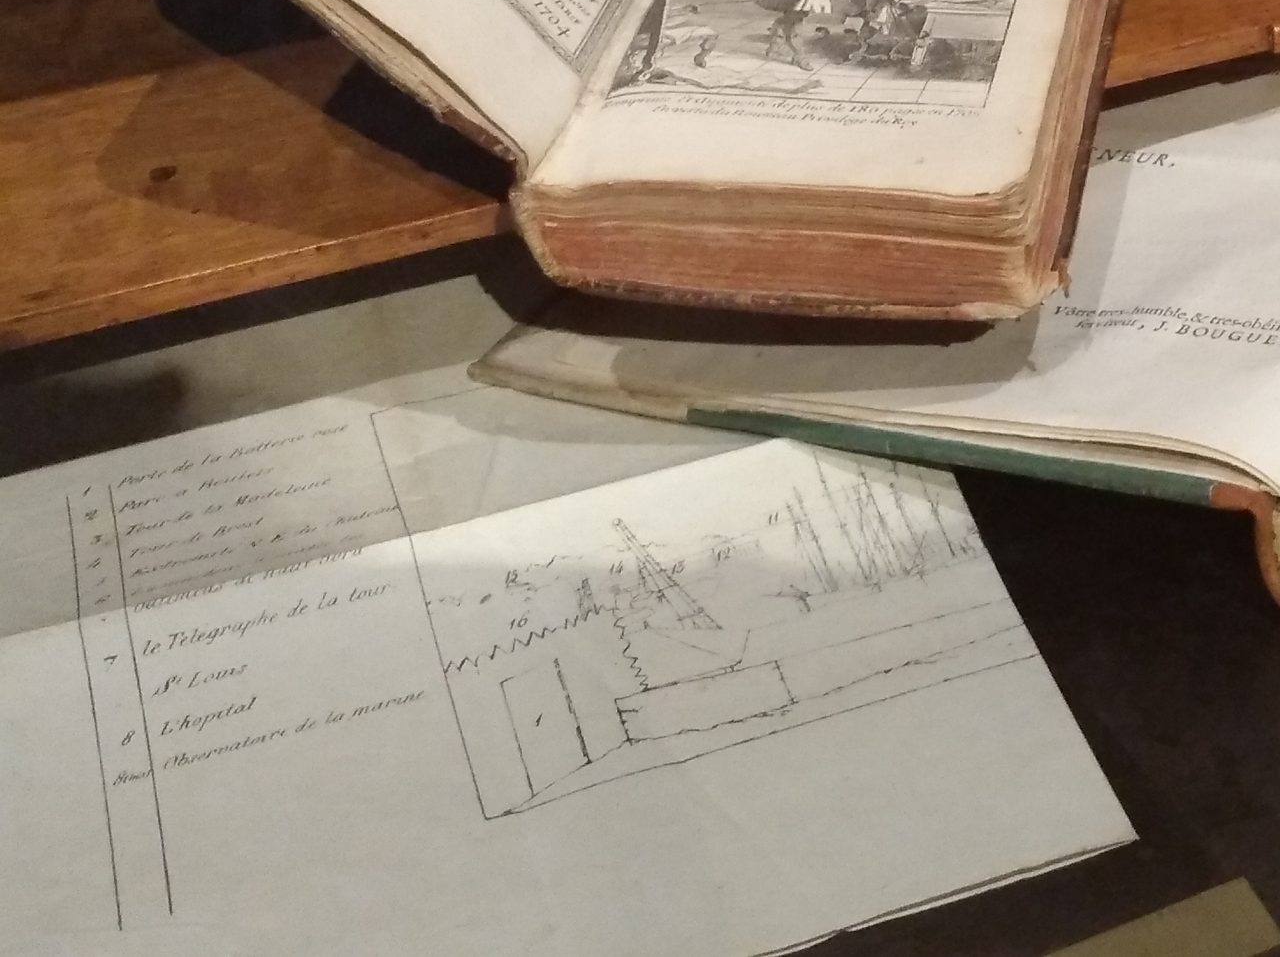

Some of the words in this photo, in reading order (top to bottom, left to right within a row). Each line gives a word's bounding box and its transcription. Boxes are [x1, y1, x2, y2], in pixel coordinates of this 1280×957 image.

[533, 1, 572, 38] 1704
[1153, 320, 1169, 333] J.
[141, 640, 162, 657] le
[286, 598, 309, 619] de
[317, 590, 339, 610] la
[348, 582, 393, 603] tour
[294, 717, 318, 735] de
[324, 711, 347, 726] la
